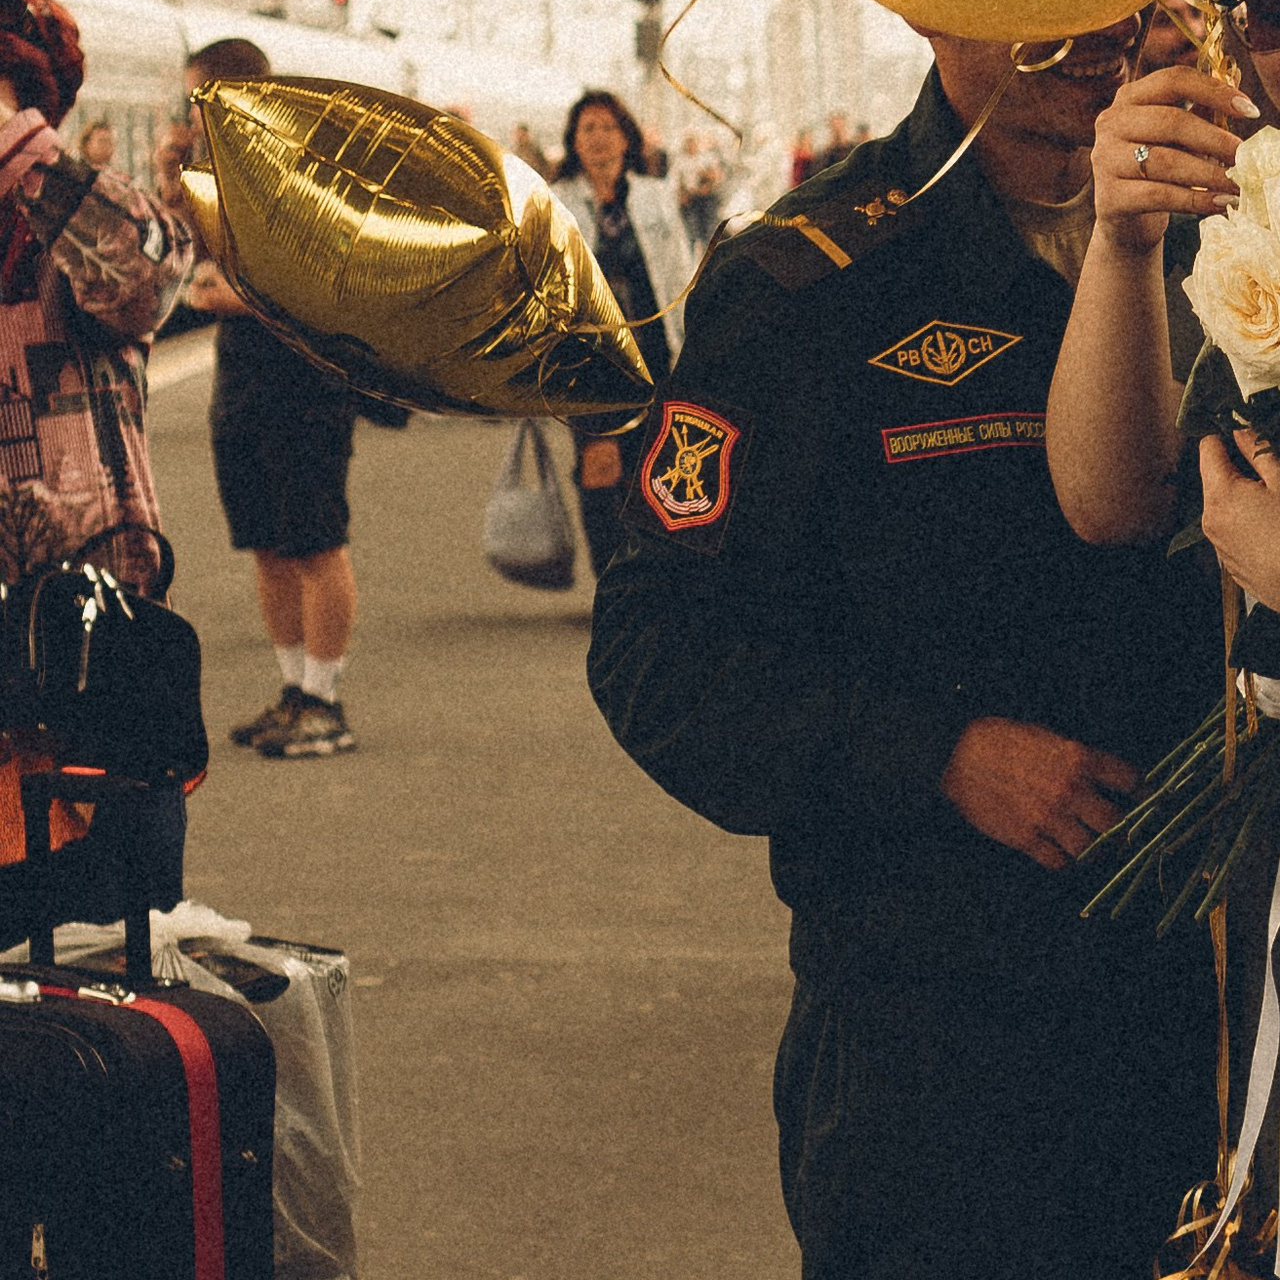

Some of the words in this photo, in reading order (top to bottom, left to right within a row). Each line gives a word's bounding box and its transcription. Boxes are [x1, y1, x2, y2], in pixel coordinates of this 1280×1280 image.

[897, 349, 921, 367] РВ
[967, 334, 993, 354] СН
[889, 425, 976, 454] ВООРУЖЕННЫЕ
[978, 421, 1012, 440] СИЛЫ
[1015, 421, 1046, 438] РОСС
